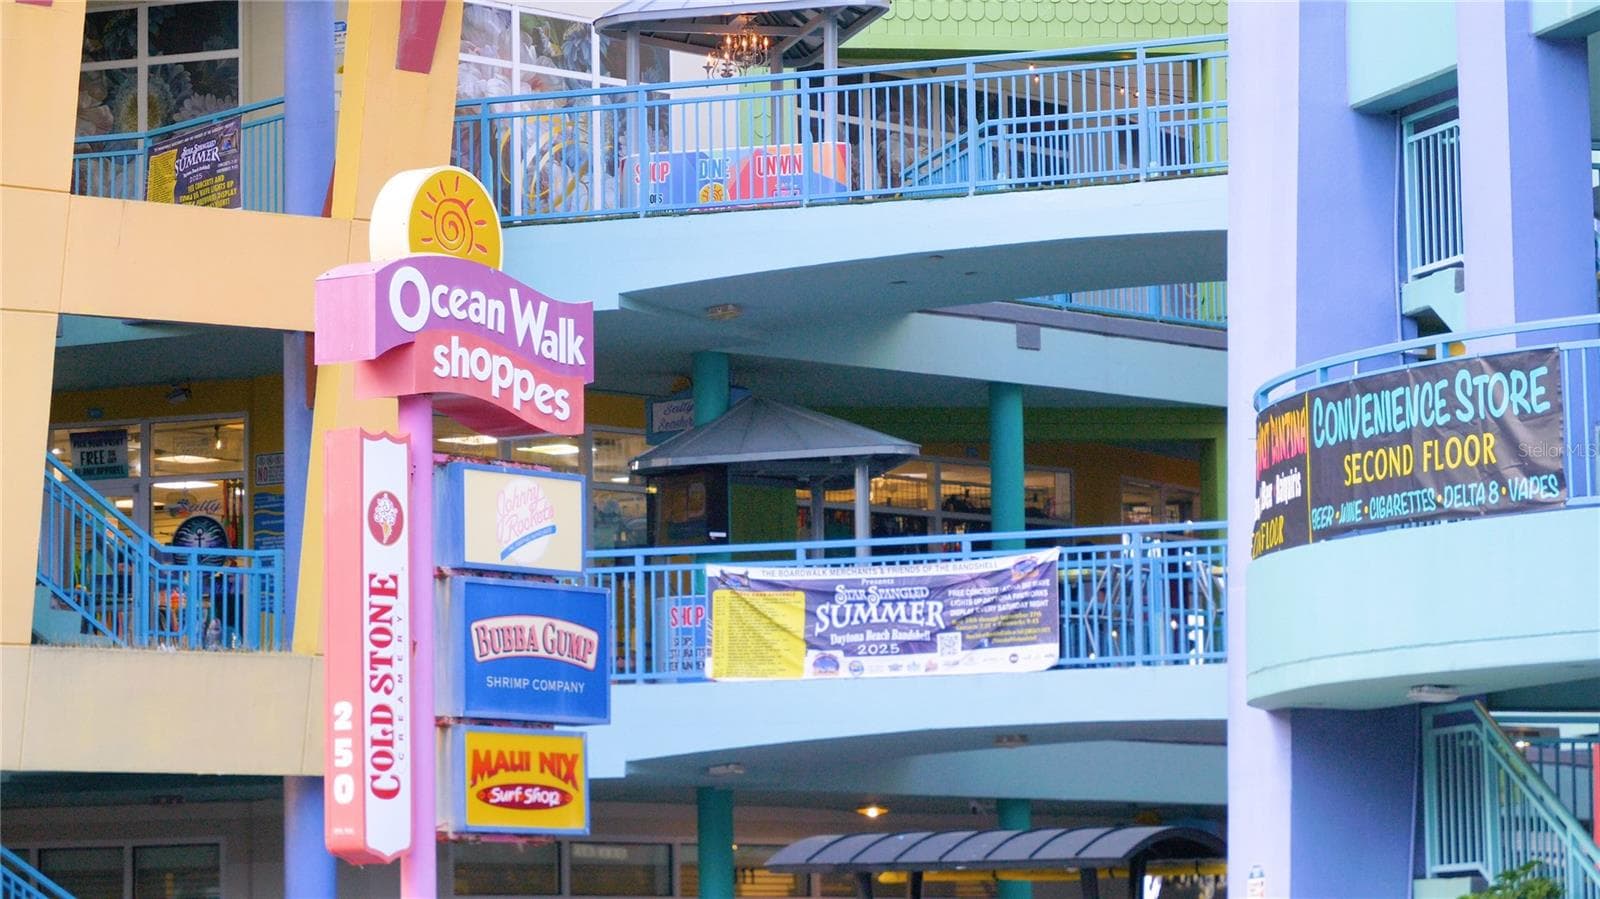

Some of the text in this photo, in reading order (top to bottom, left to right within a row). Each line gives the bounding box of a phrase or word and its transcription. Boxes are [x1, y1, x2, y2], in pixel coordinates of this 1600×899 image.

[174, 147, 221, 177] SUMMER
[633, 161, 671, 185] SOP
[700, 158, 731, 181] DNE
[389, 266, 586, 366] Ocean Walk
[432, 336, 571, 421] shoppes
[1312, 365, 1551, 449] CONVENIENCE STORE
[80, 450, 105, 466] FREE
[1344, 432, 1497, 487] SECOND FLOOR
[1311, 474, 1560, 531] BEER WINE CIGARETTES DELTA 8 VAPES
[778, 568, 829, 577] BOARDWALK
[887, 564, 920, 574] FRIENDS
[951, 559, 997, 570] BANDSHELL
[834, 585, 931, 605] STAR SPANGLED
[814, 600, 946, 637] SUMMER
[830, 628, 932, 647] Daytona Beach Bandshell
[475, 621, 596, 665] BUBBA GUMP
[857, 643, 901, 656] 2025
[368, 573, 401, 801] COLD STONE
[396, 615, 405, 761] CREAMERY
[486, 675, 586, 694] SHRIMP COMPANY
[333, 701, 356, 806] 250
[470, 748, 581, 792] MAUI NIX
[489, 786, 562, 807] Surf Shop
